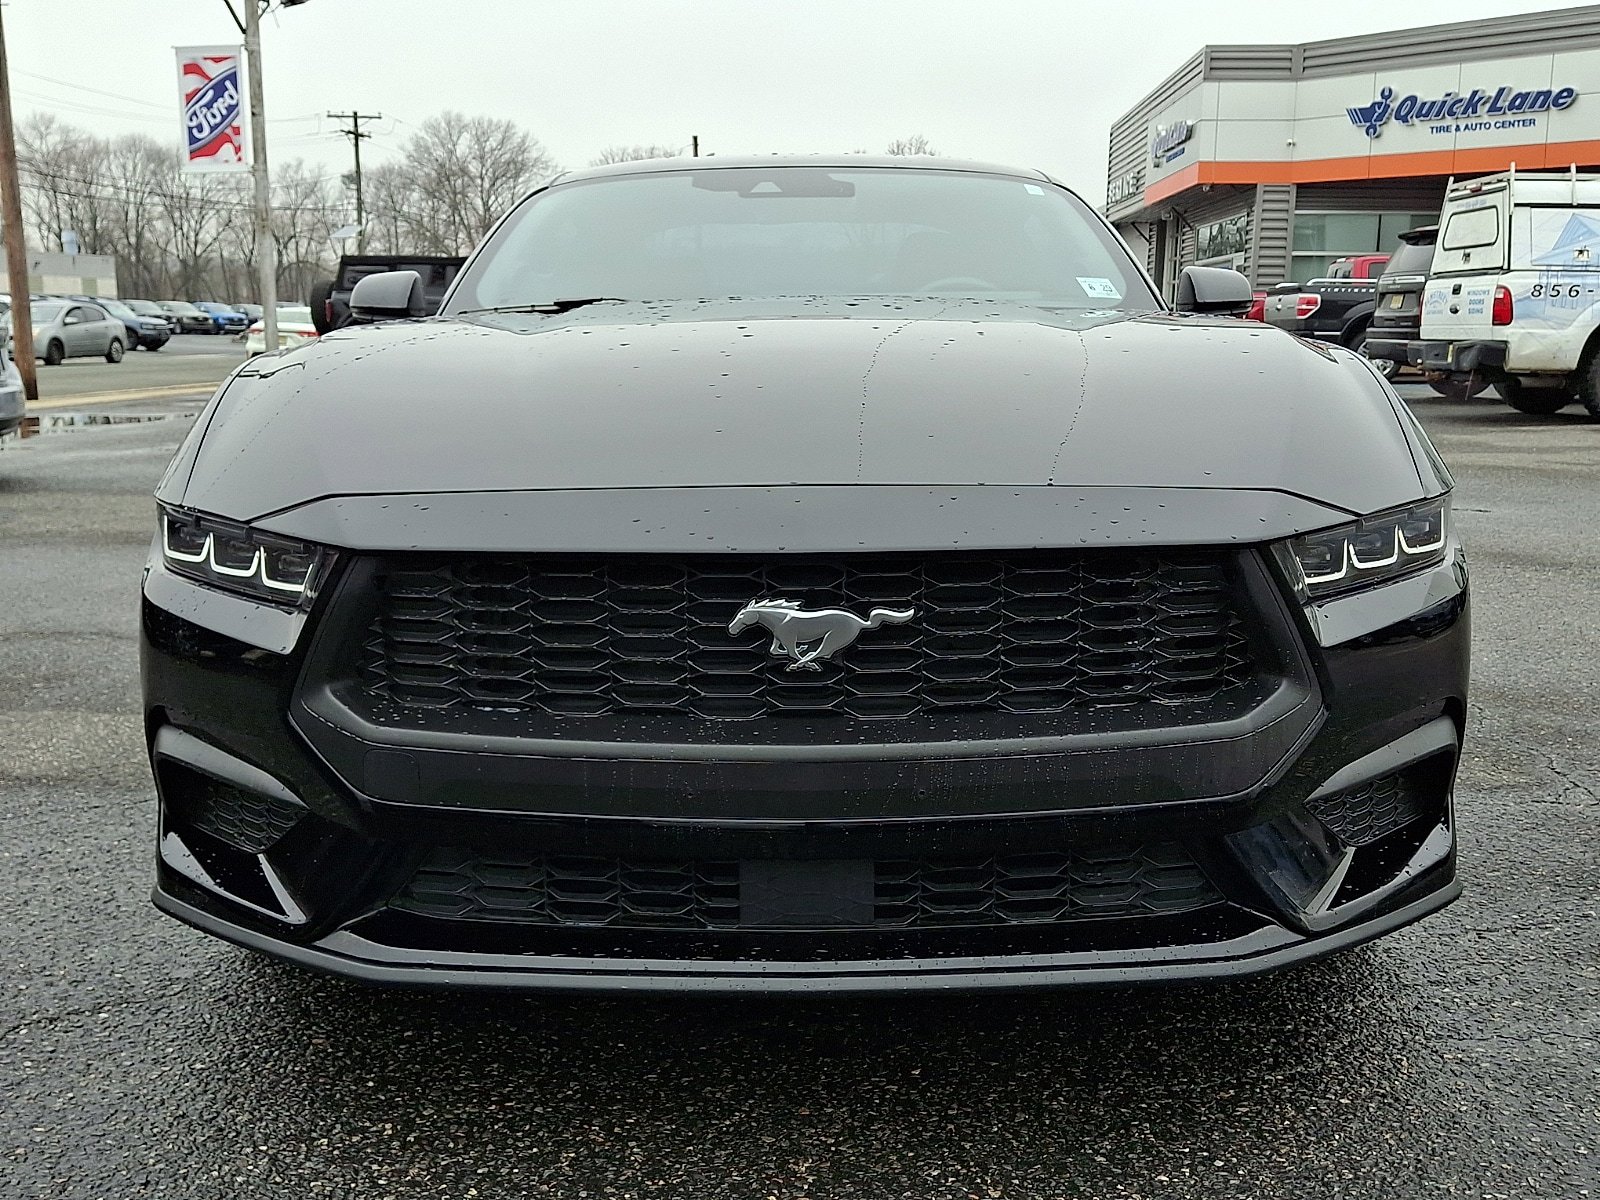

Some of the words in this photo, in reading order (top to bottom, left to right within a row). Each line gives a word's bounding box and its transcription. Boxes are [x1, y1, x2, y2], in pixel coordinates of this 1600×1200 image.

[186, 80, 239, 139] Ford
[1393, 89, 1486, 124] Quick
[1486, 86, 1576, 114] Lane
[1429, 125, 1452, 135] TIRE
[1454, 124, 1461, 133] &
[1463, 122, 1492, 132] AUTO
[1494, 118, 1537, 130] CENTER
